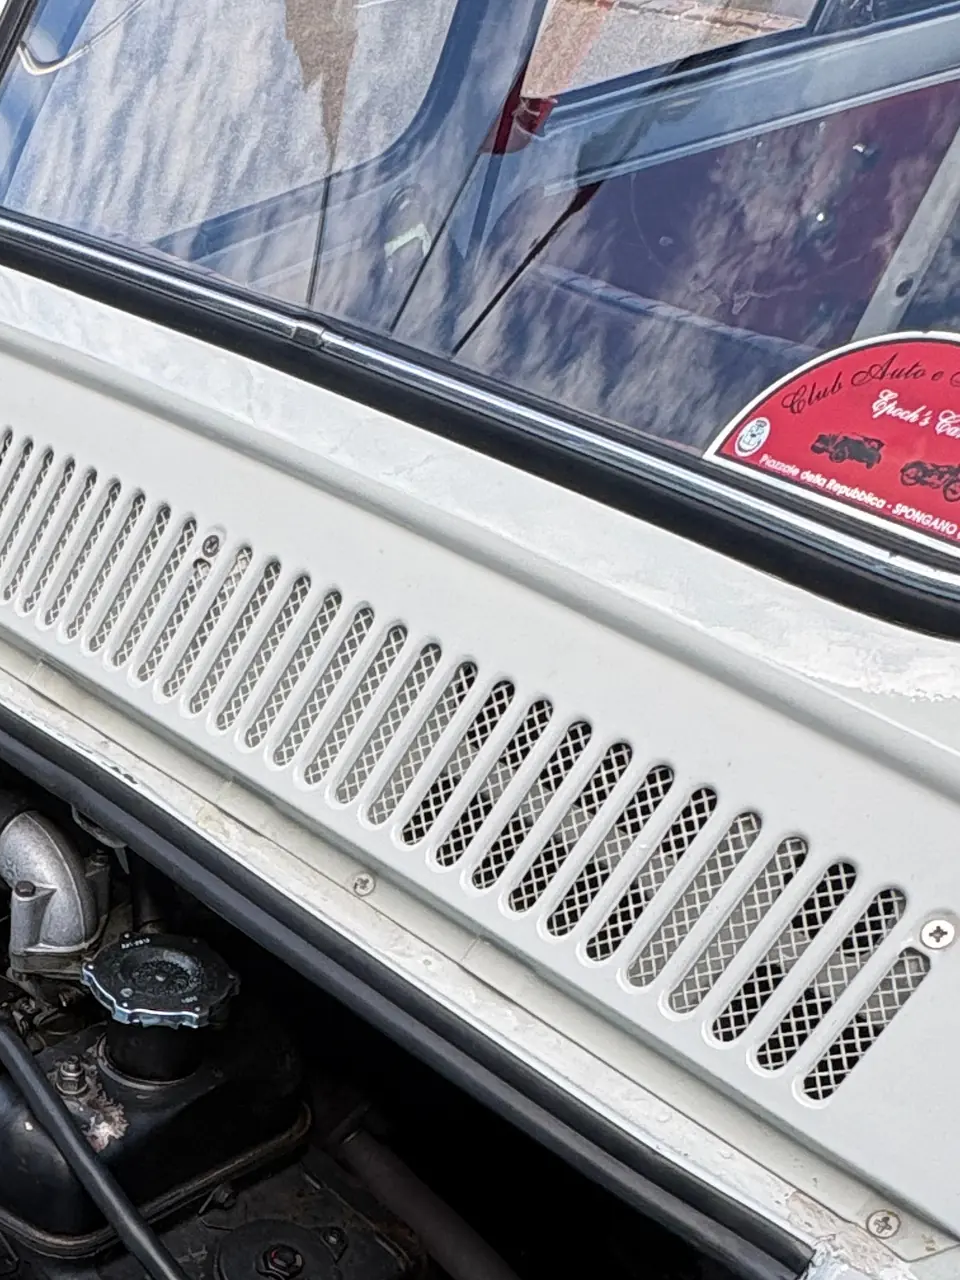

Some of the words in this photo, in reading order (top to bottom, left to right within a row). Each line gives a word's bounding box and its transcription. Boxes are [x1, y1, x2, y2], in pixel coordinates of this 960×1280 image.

[781, 371, 843, 414] Club
[851, 353, 926, 387] Auto
[931, 370, 944, 381] e
[872, 389, 932, 427] Epoch's
[935, 409, 960, 438] Ca
[800, 470, 827, 488] della
[826, 478, 887, 509] Repubblica
[891, 502, 958, 535] SPONGANO
